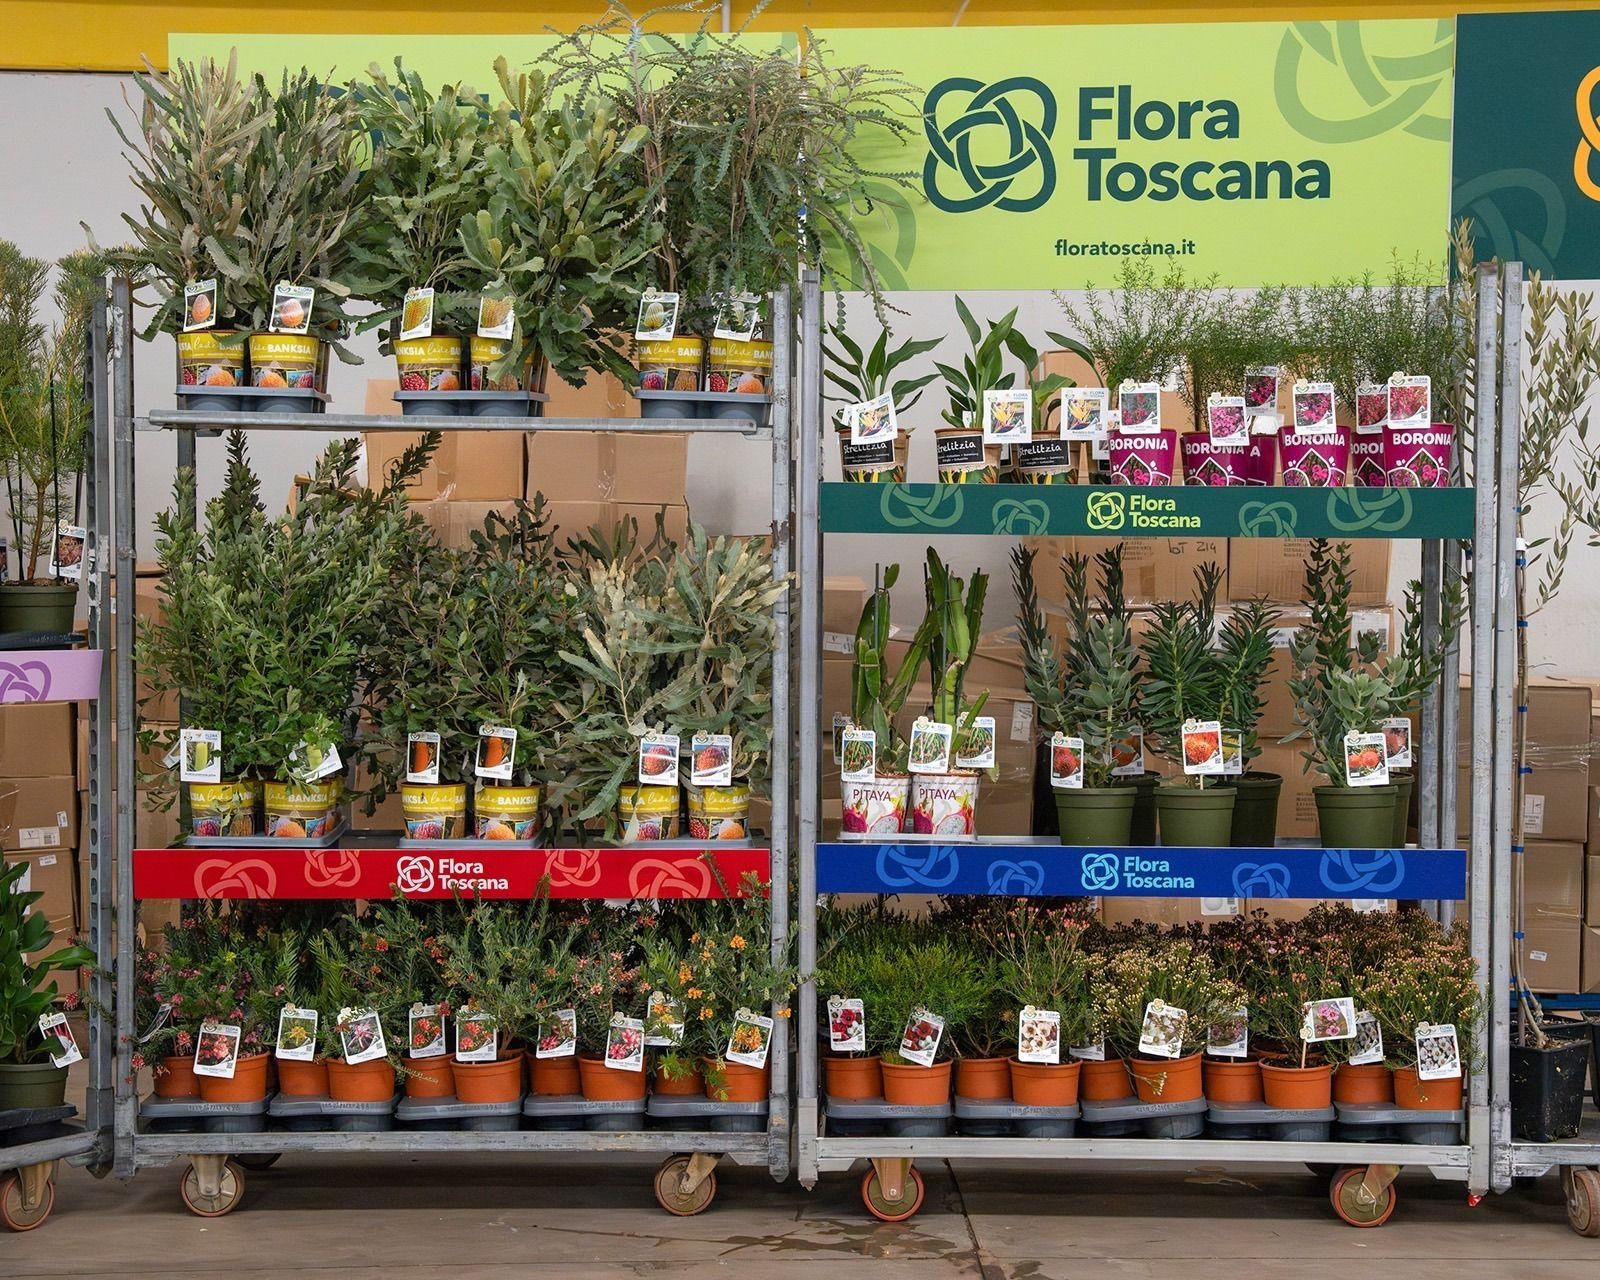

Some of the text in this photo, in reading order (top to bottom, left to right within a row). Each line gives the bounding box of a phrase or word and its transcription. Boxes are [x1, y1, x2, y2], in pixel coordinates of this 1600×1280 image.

[1078, 85, 1240, 141] Flora
[1073, 147, 1331, 202] Toscana
[1054, 239, 1196, 256] floratoscana.it
[267, 343, 312, 355] BANKSIA
[1109, 437, 1169, 450] BORONIA
[1284, 433, 1345, 447] BORONIA
[1392, 432, 1451, 446] BORONIA
[1185, 442, 1245, 455] BORONIA
[1130, 495, 1176, 511] Flora
[1129, 511, 1201, 528] Toscana
[852, 788, 892, 802] PITAYA
[919, 788, 957, 801] PITAYA
[439, 858, 484, 874] Flora
[1124, 856, 1170, 873] Flora
[439, 874, 510, 891] Toscana
[1124, 872, 1195, 890] Toscana
